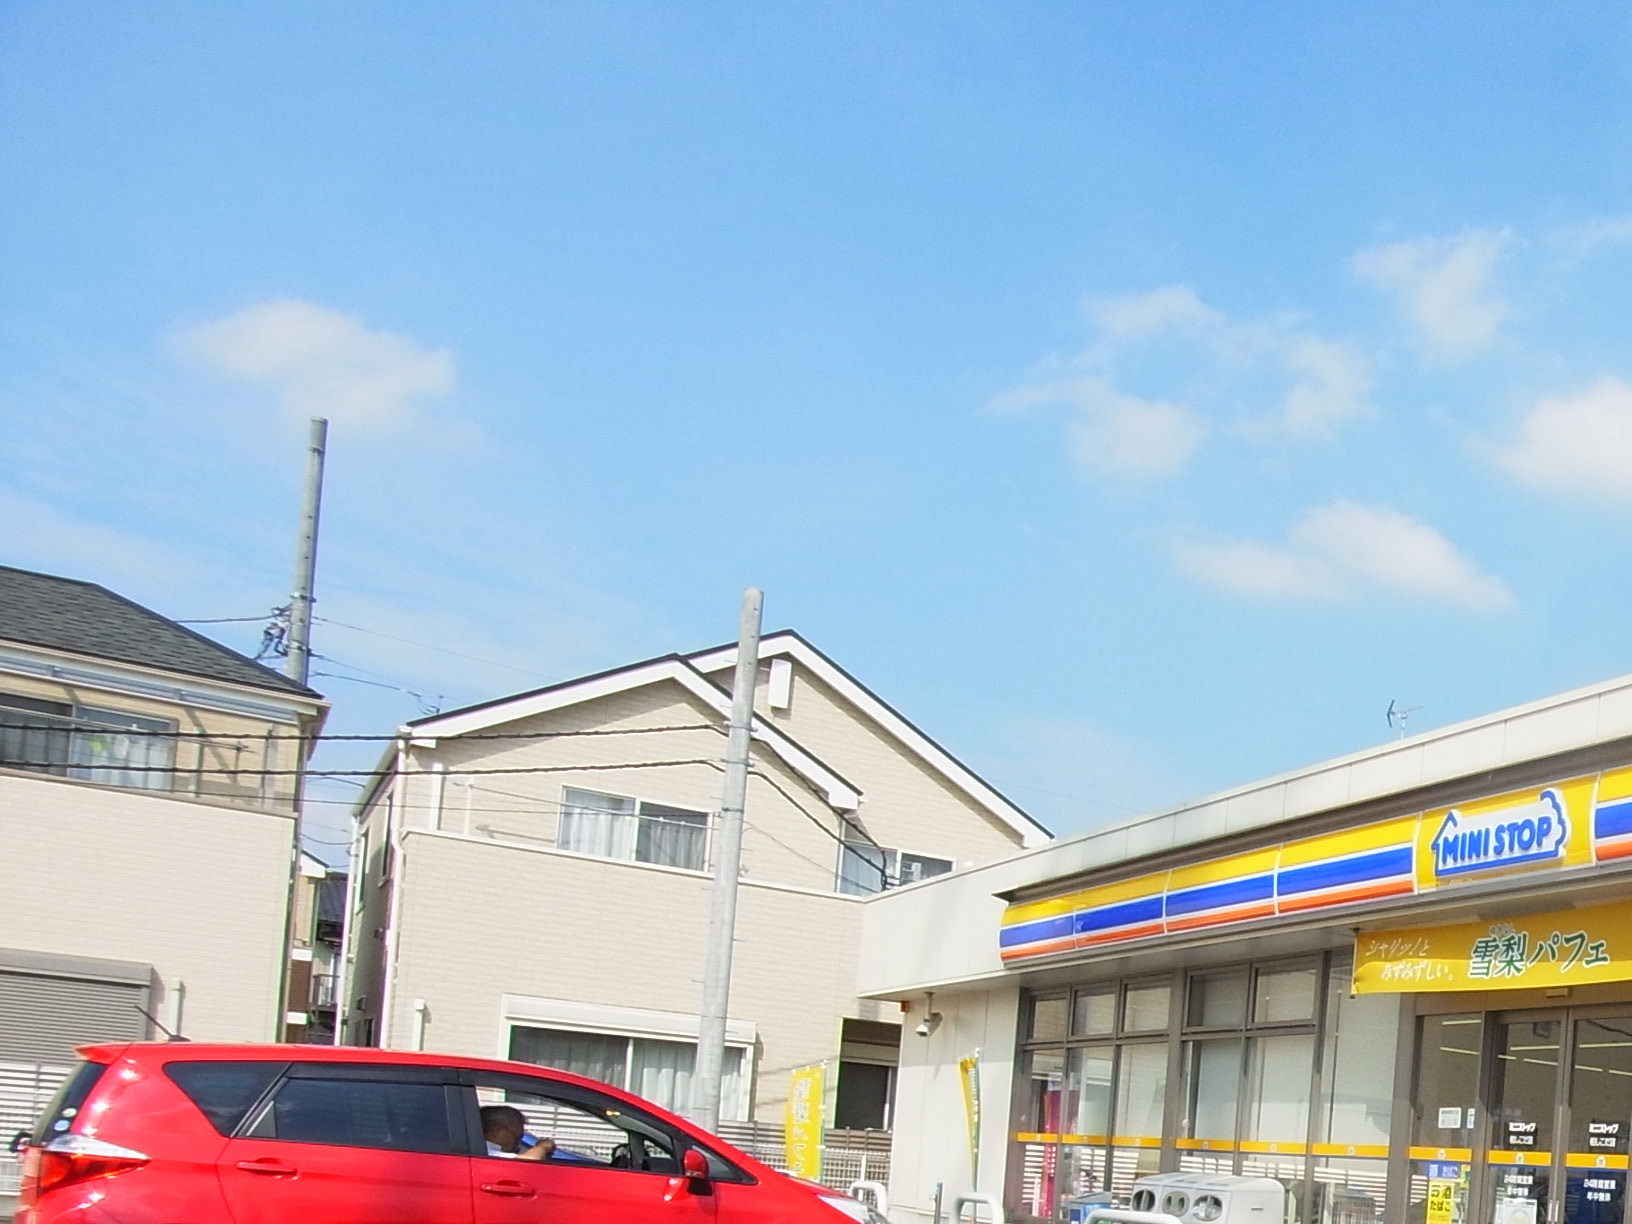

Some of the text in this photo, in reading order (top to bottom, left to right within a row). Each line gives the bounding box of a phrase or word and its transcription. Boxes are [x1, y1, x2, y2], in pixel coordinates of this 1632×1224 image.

[1441, 816, 1552, 865] MINI STOP
[1468, 930, 1610, 979] 雪梨パフェ
